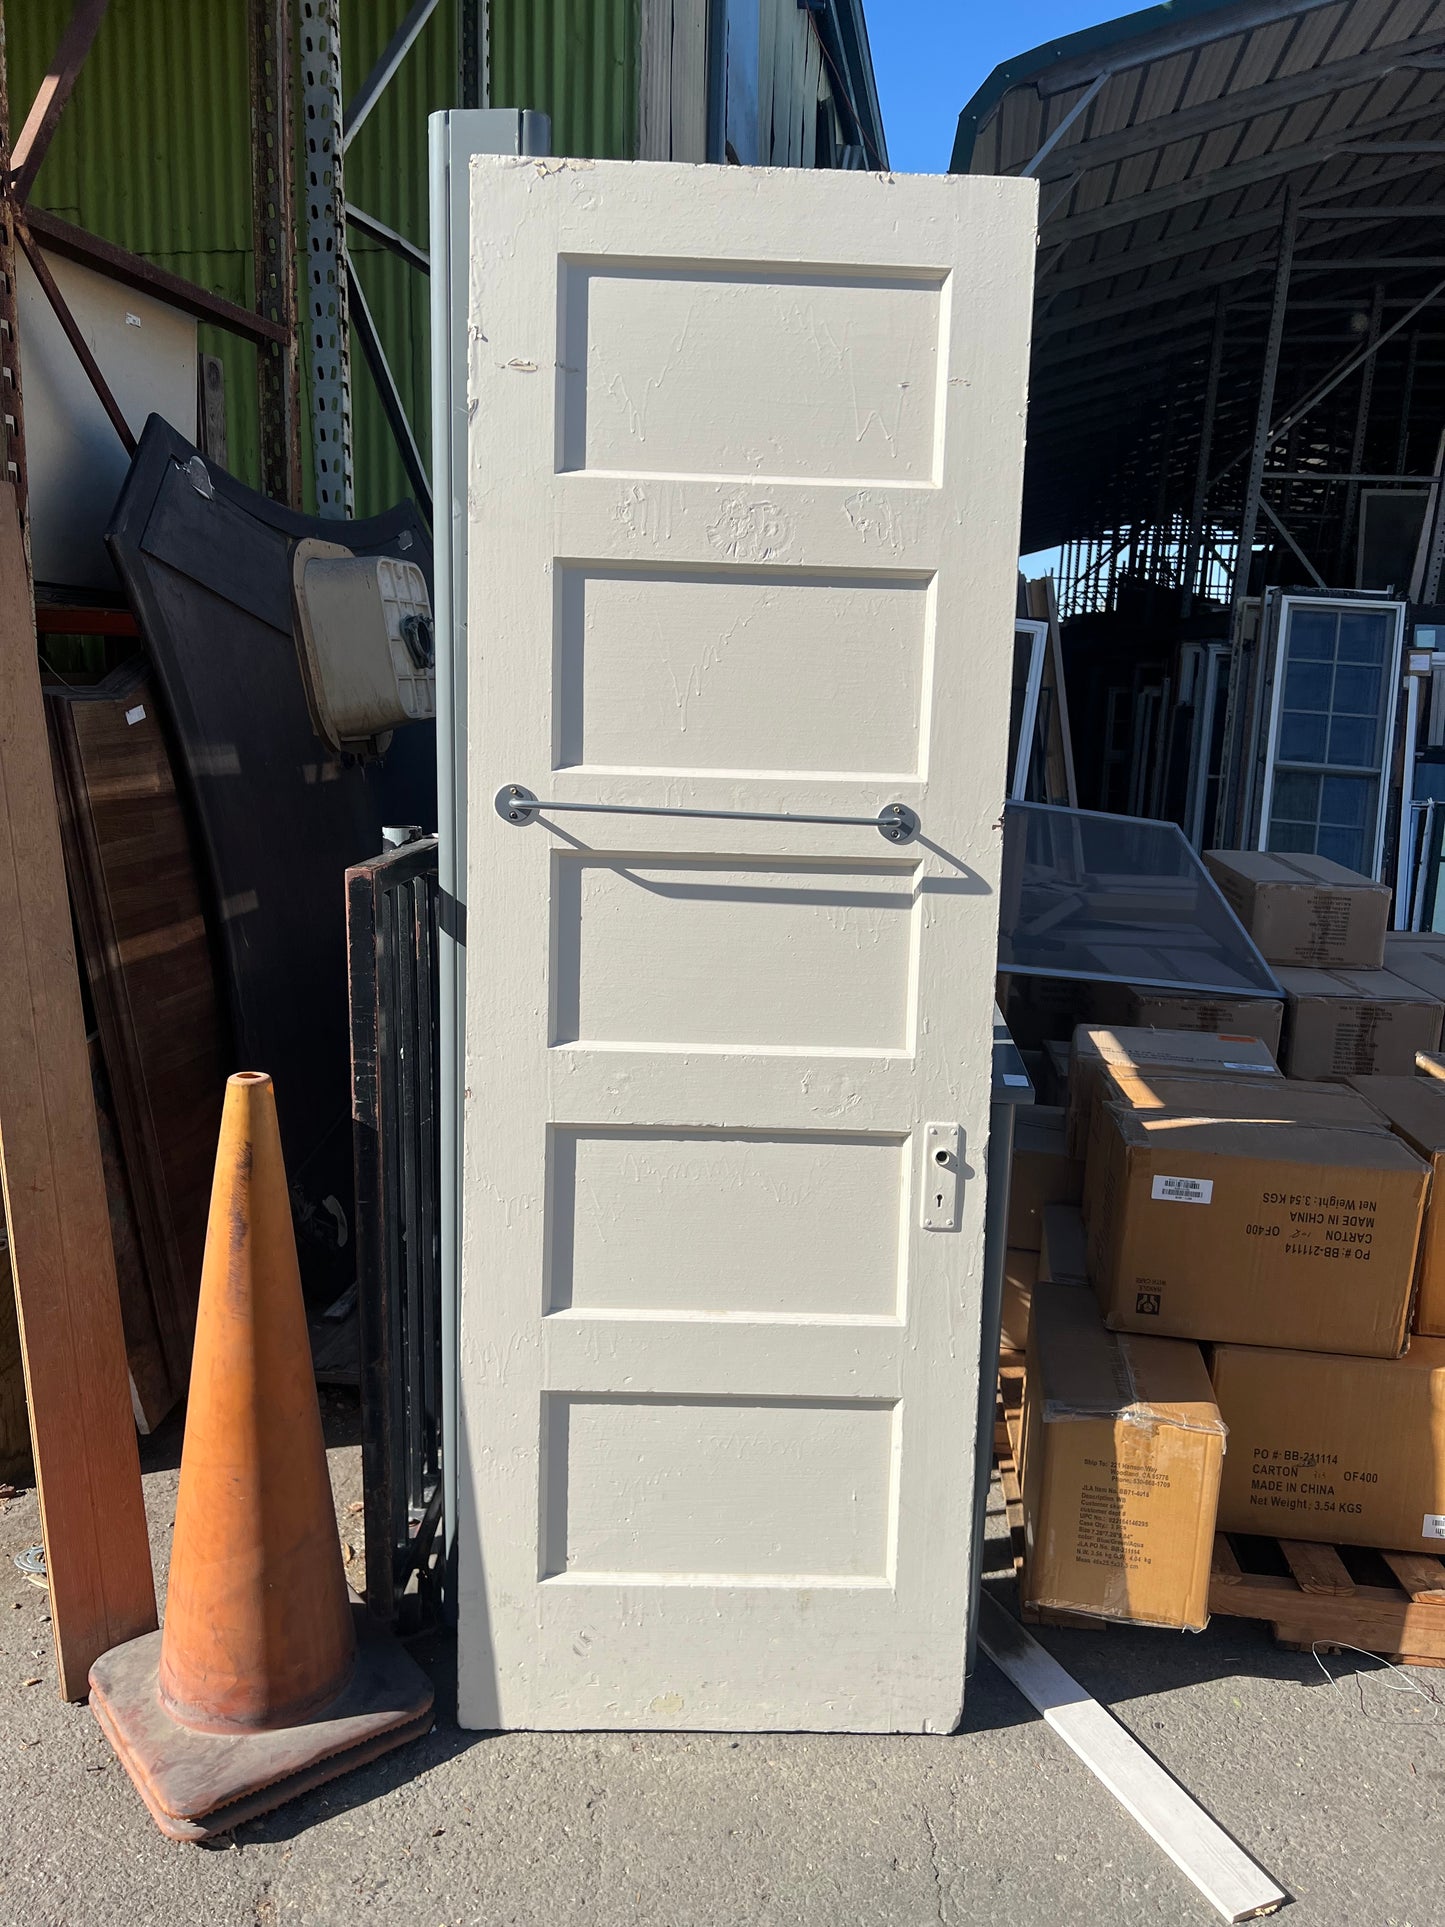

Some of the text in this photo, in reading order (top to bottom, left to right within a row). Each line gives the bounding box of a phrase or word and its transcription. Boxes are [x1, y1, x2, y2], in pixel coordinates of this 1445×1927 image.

[1262, 1192, 1377, 1212] Net Weight: 3.54 KGS
[1289, 1211, 1375, 1228] MADE IN CHINA
[1326, 1230, 1373, 1244] CARTON
[1284, 1243, 1340, 1258] BB-211114
[1354, 1248, 1370, 1260] PO
[1253, 1448, 1269, 1459] PO
[1284, 1450, 1338, 1465] BB-211114
[1110, 1461, 1121, 1469] 221
[1145, 1466, 1158, 1474] Way
[1252, 1464, 1298, 1477] CARTON
[1251, 1480, 1335, 1495] MADE IN CHINA
[1250, 1495, 1363, 1514] Net Weight: 3.54 KGS
